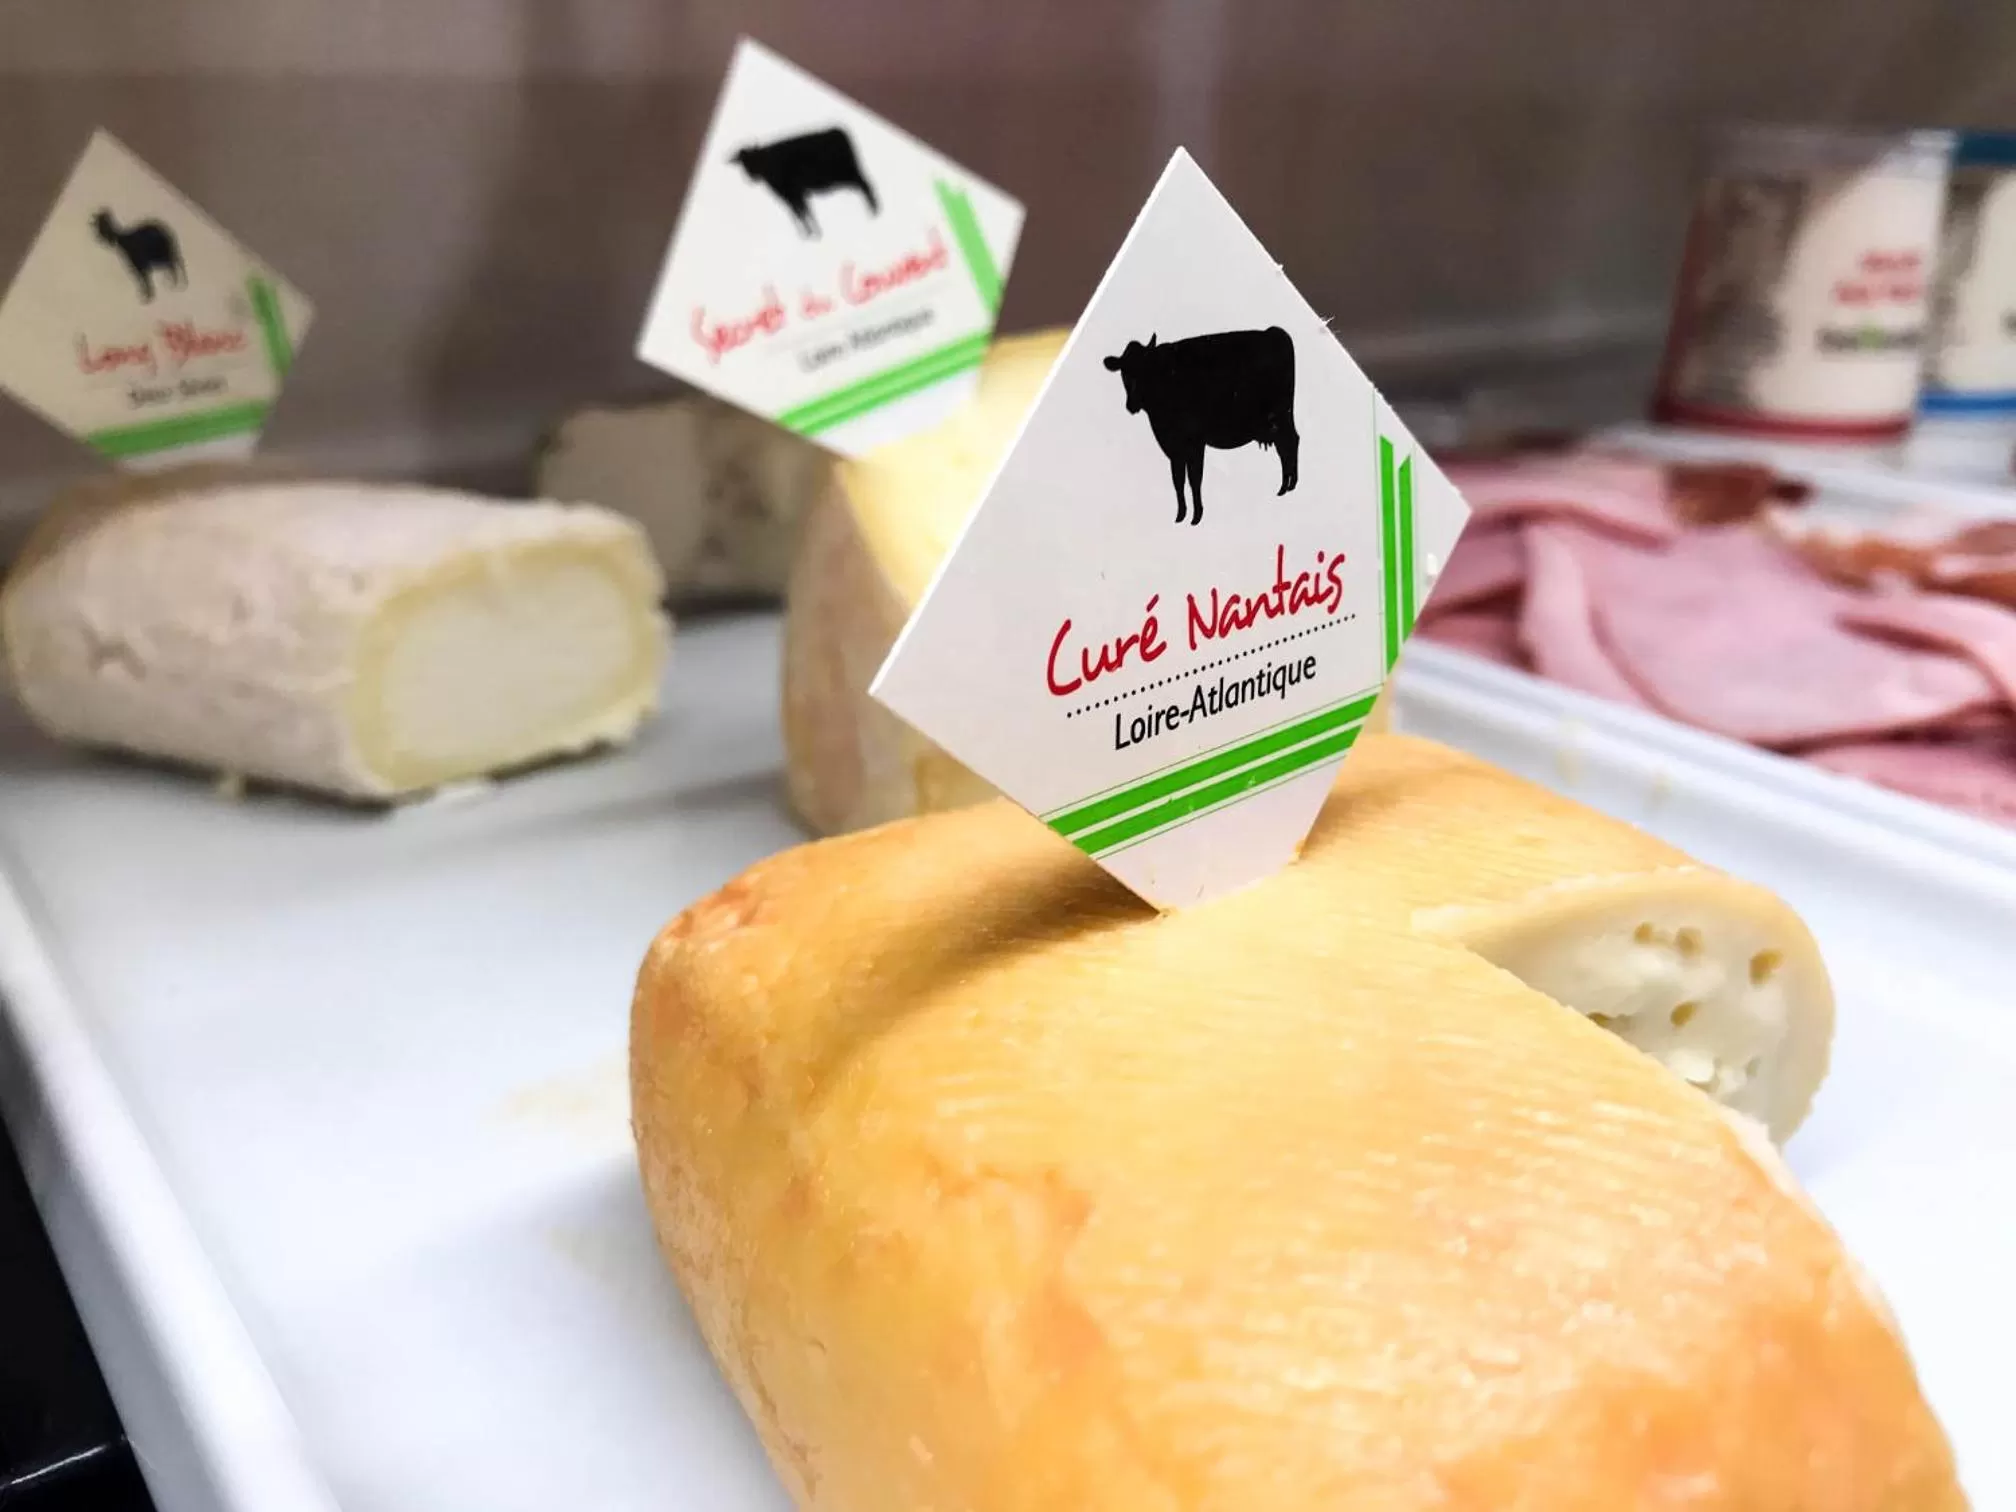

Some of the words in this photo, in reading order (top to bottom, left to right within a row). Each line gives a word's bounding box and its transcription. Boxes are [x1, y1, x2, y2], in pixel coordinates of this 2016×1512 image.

[1046, 594, 1168, 696] Curé
[1186, 544, 1346, 650] Nantais
[1115, 655, 1317, 750] Loire-Atlantique
